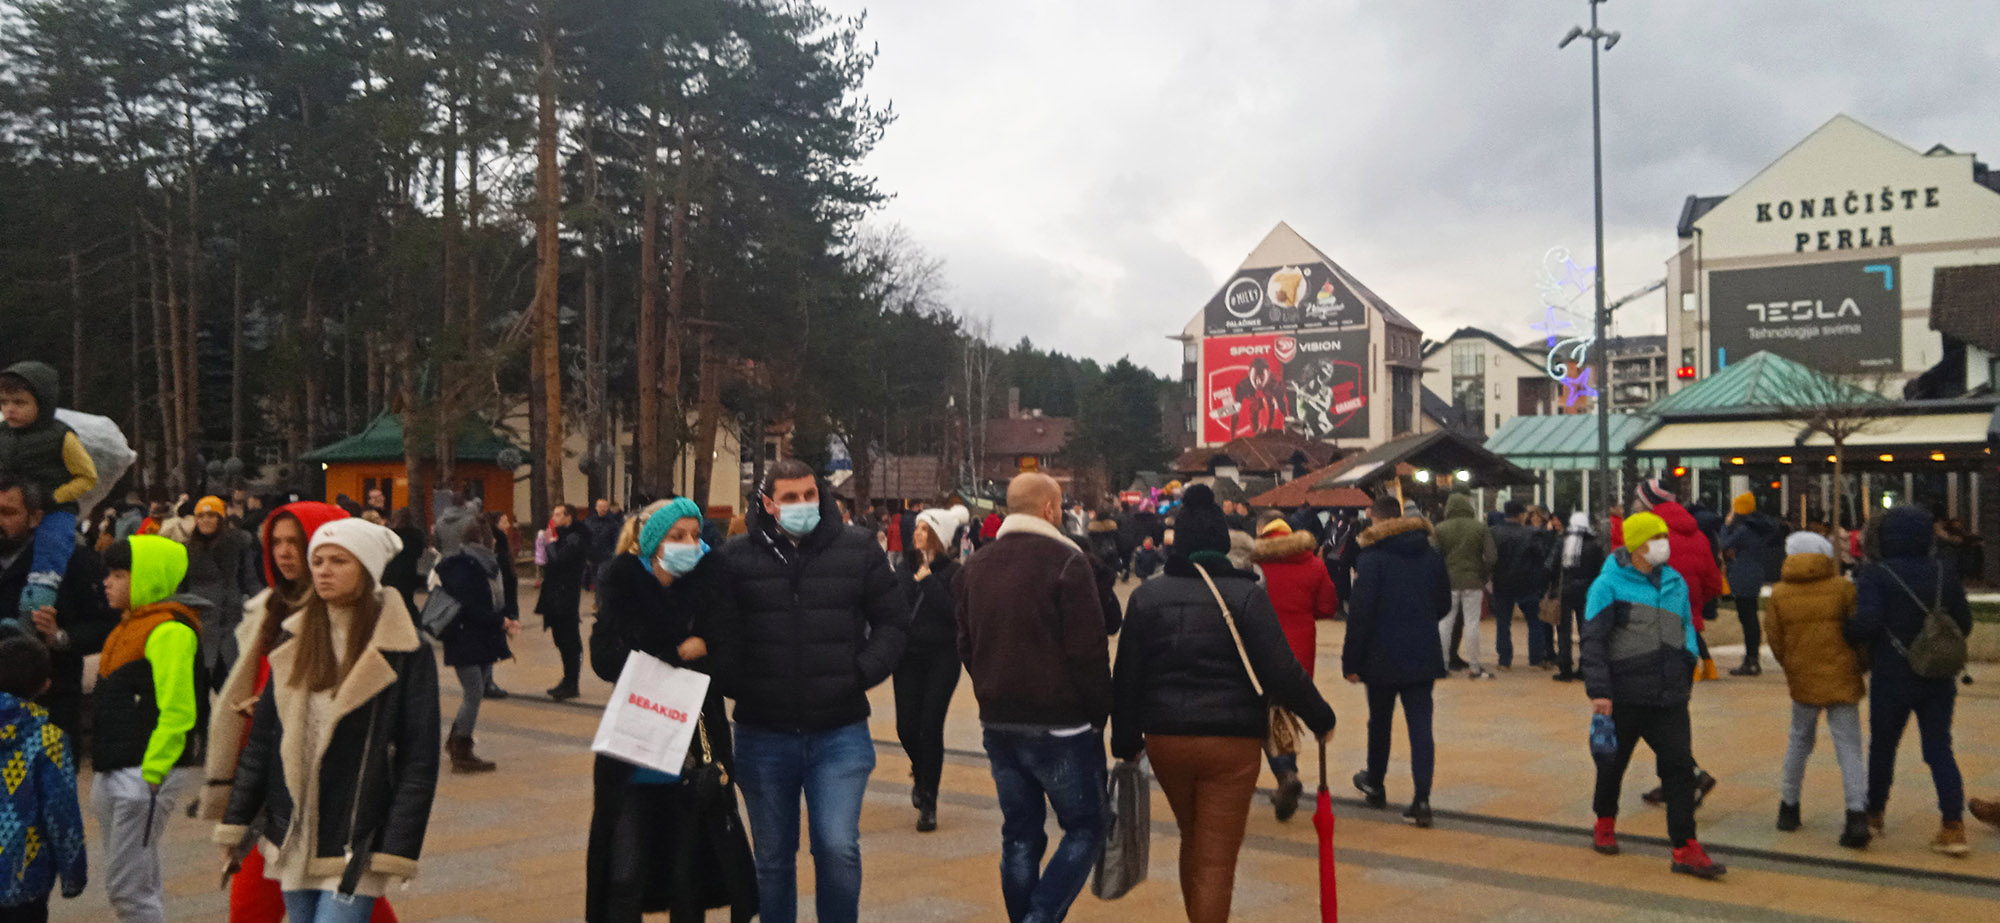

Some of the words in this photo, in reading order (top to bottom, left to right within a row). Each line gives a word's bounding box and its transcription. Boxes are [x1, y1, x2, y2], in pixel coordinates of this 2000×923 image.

[1756, 186, 1940, 222] KONAČIŠTE
[1796, 226, 1895, 252] PERLA
[1746, 297, 1862, 322] TESLA
[1748, 326, 1819, 340] Tehnologija
[1822, 323, 1862, 335] svima
[1230, 344, 1271, 356] SPORT
[1299, 340, 1342, 352] VISION
[628, 692, 688, 723] BEBAKIDS
